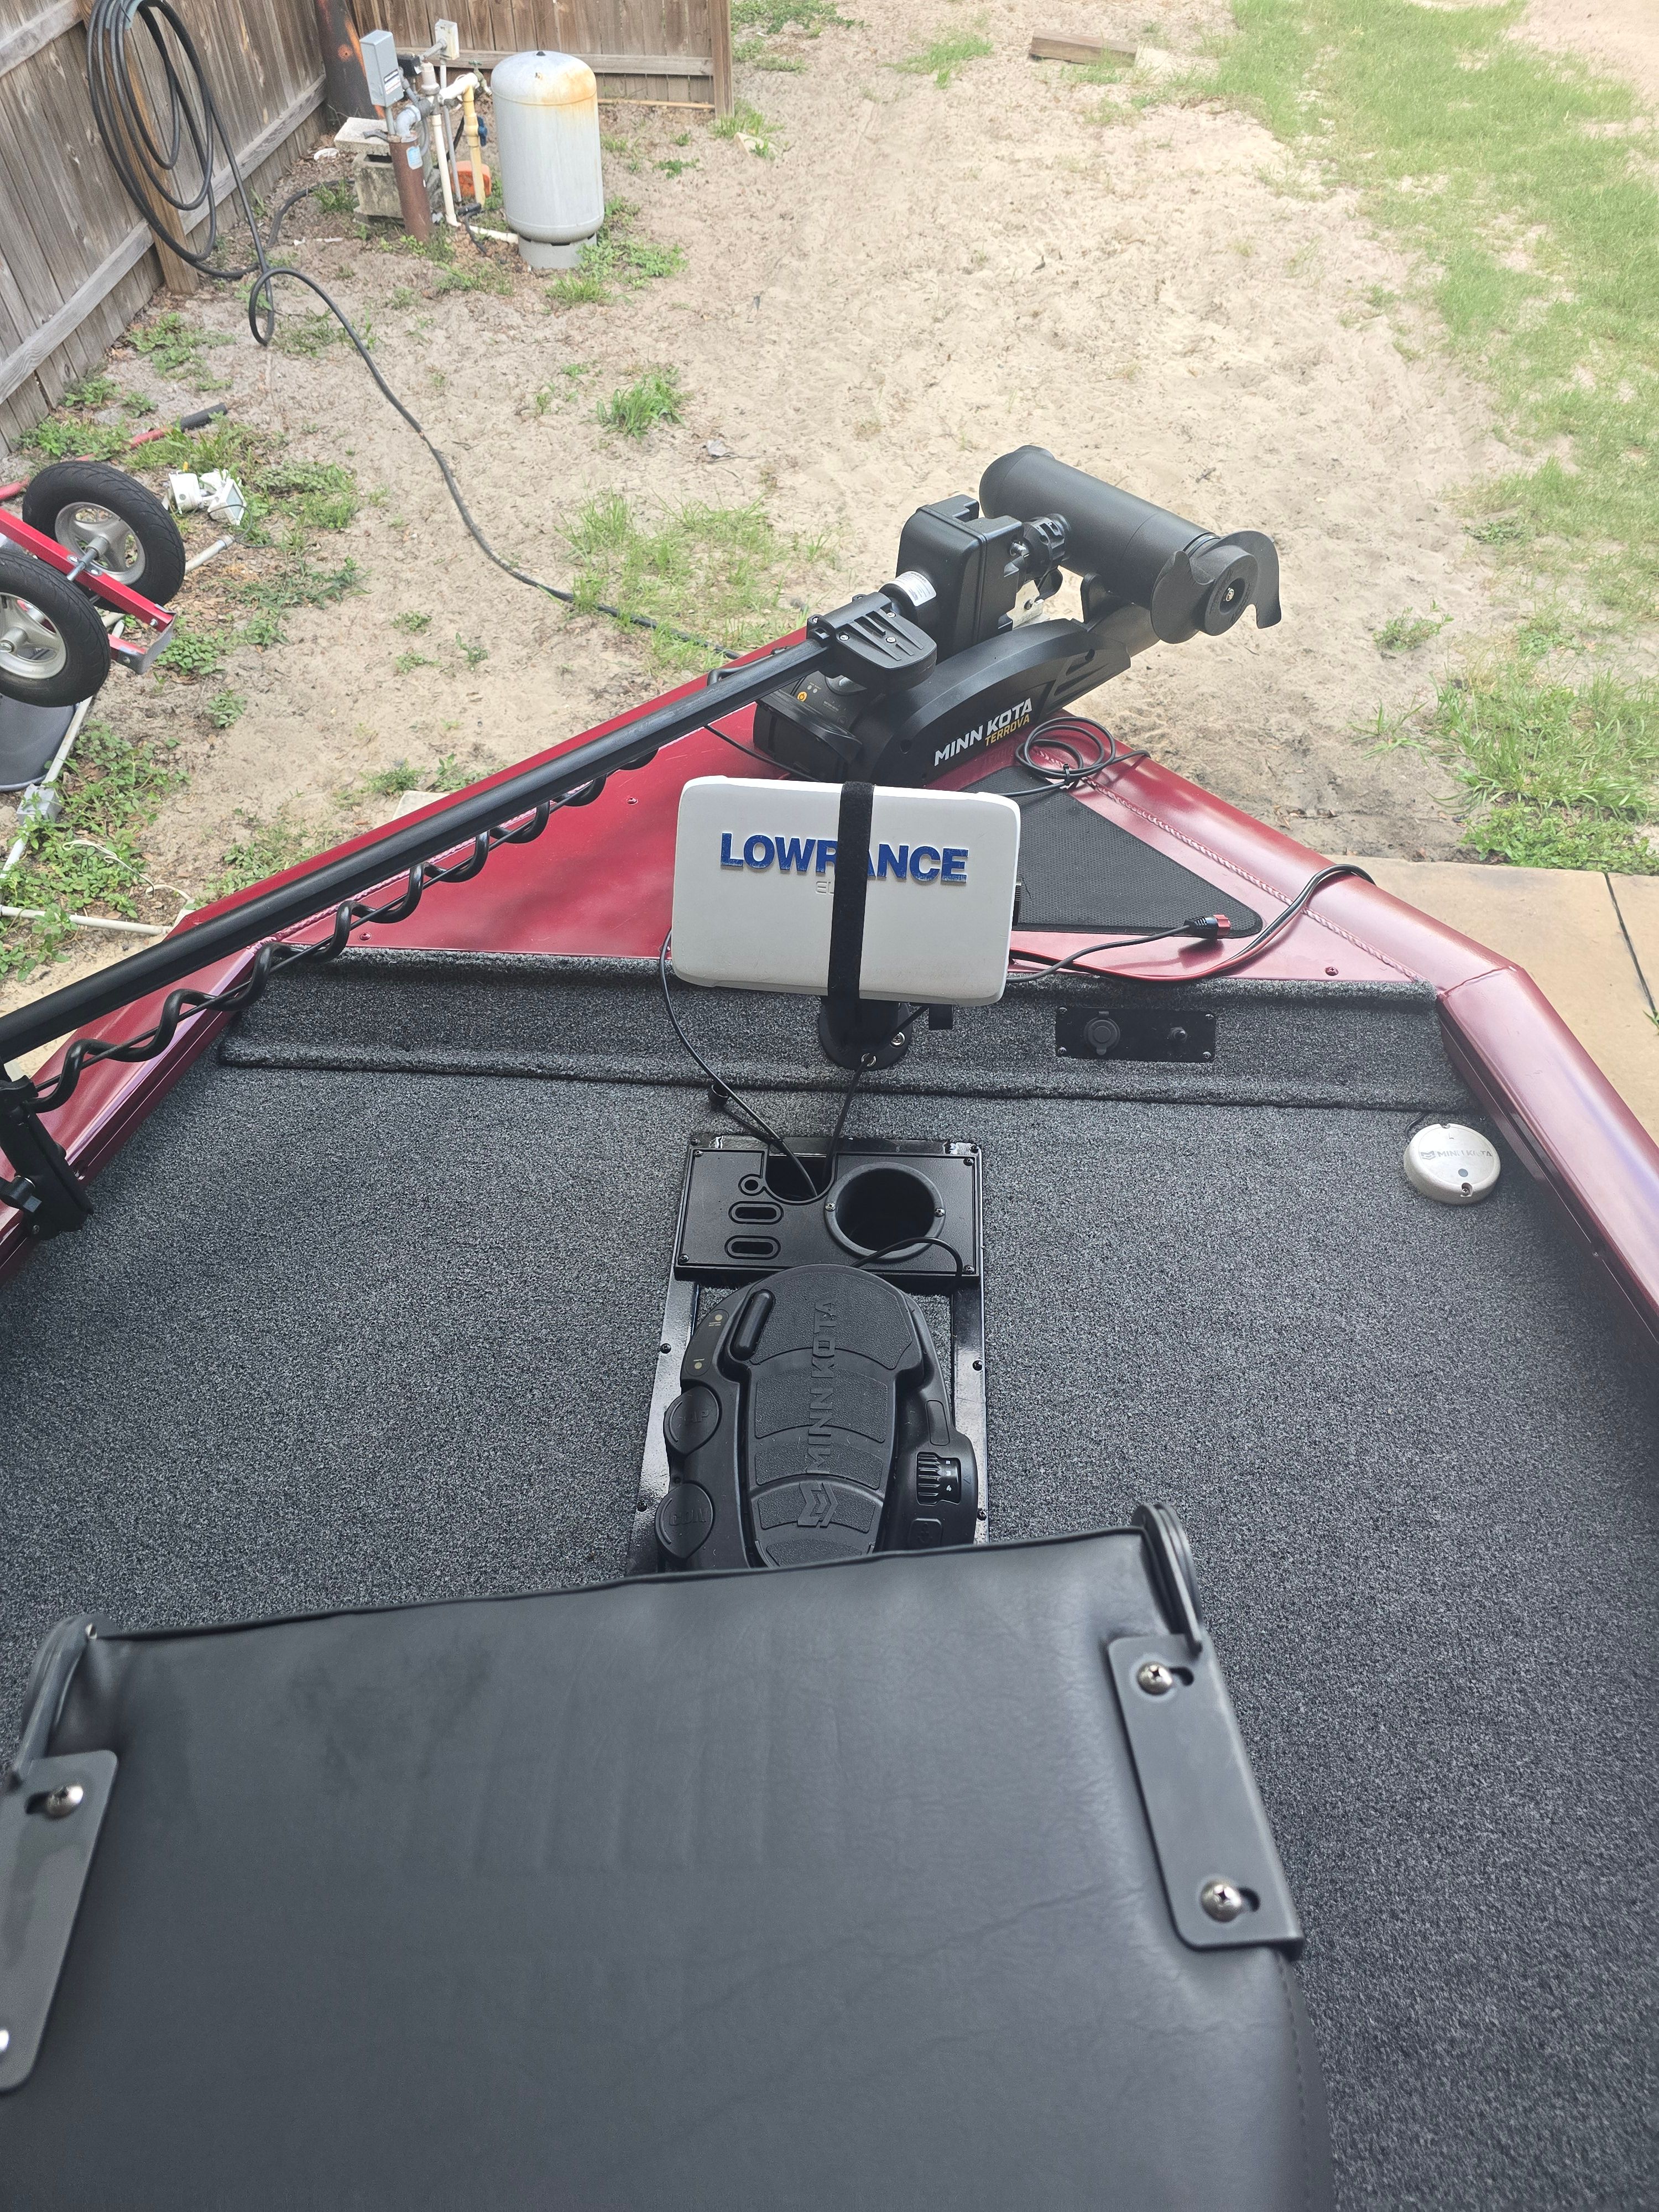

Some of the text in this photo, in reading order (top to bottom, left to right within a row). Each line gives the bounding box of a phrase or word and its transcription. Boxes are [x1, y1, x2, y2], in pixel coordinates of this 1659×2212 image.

[934, 698, 1032, 766] MINN KOTA
[985, 714, 1030, 747] TERROVA
[721, 833, 969, 884] LOWRNCE
[807, 1300, 836, 1475] MINN KOTA
